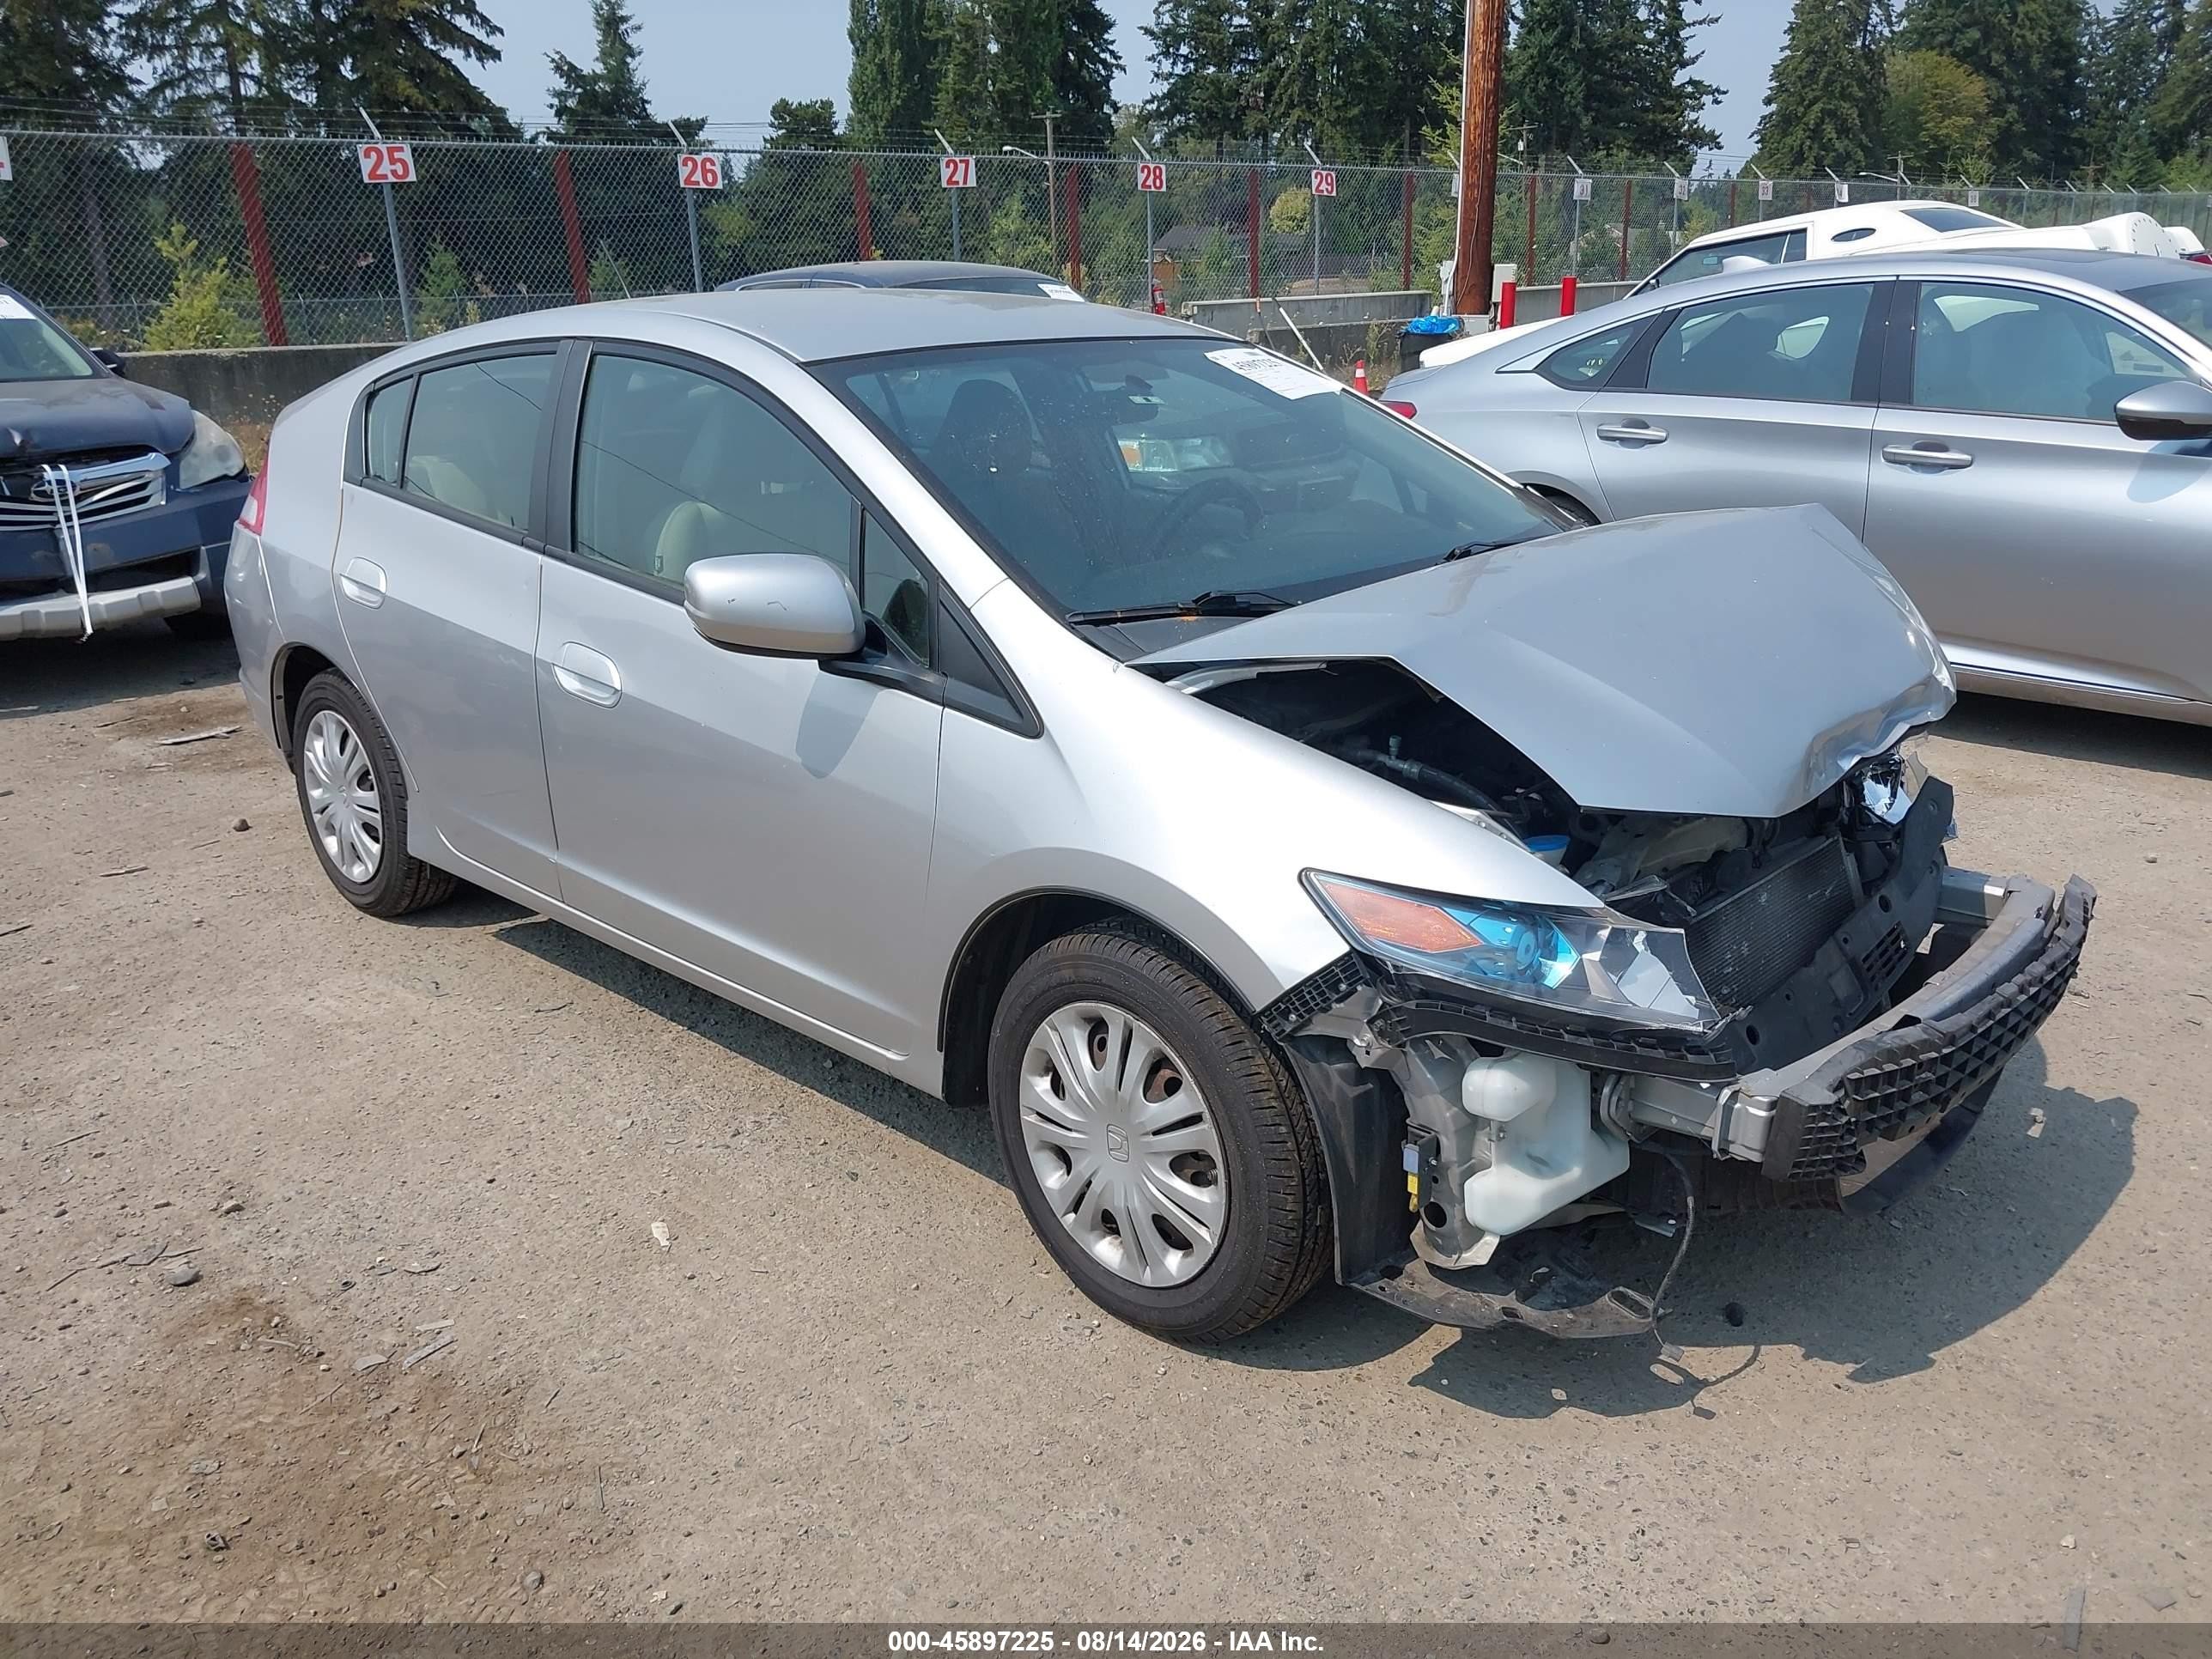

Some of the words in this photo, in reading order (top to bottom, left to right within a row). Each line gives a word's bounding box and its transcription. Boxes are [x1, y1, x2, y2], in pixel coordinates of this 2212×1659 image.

[363, 146, 410, 180] 25
[683, 156, 718, 186] 26
[945, 159, 969, 185] 27
[1140, 164, 1164, 190] 28
[1315, 172, 1334, 194] 29
[1580, 185, 1589, 195] 31
